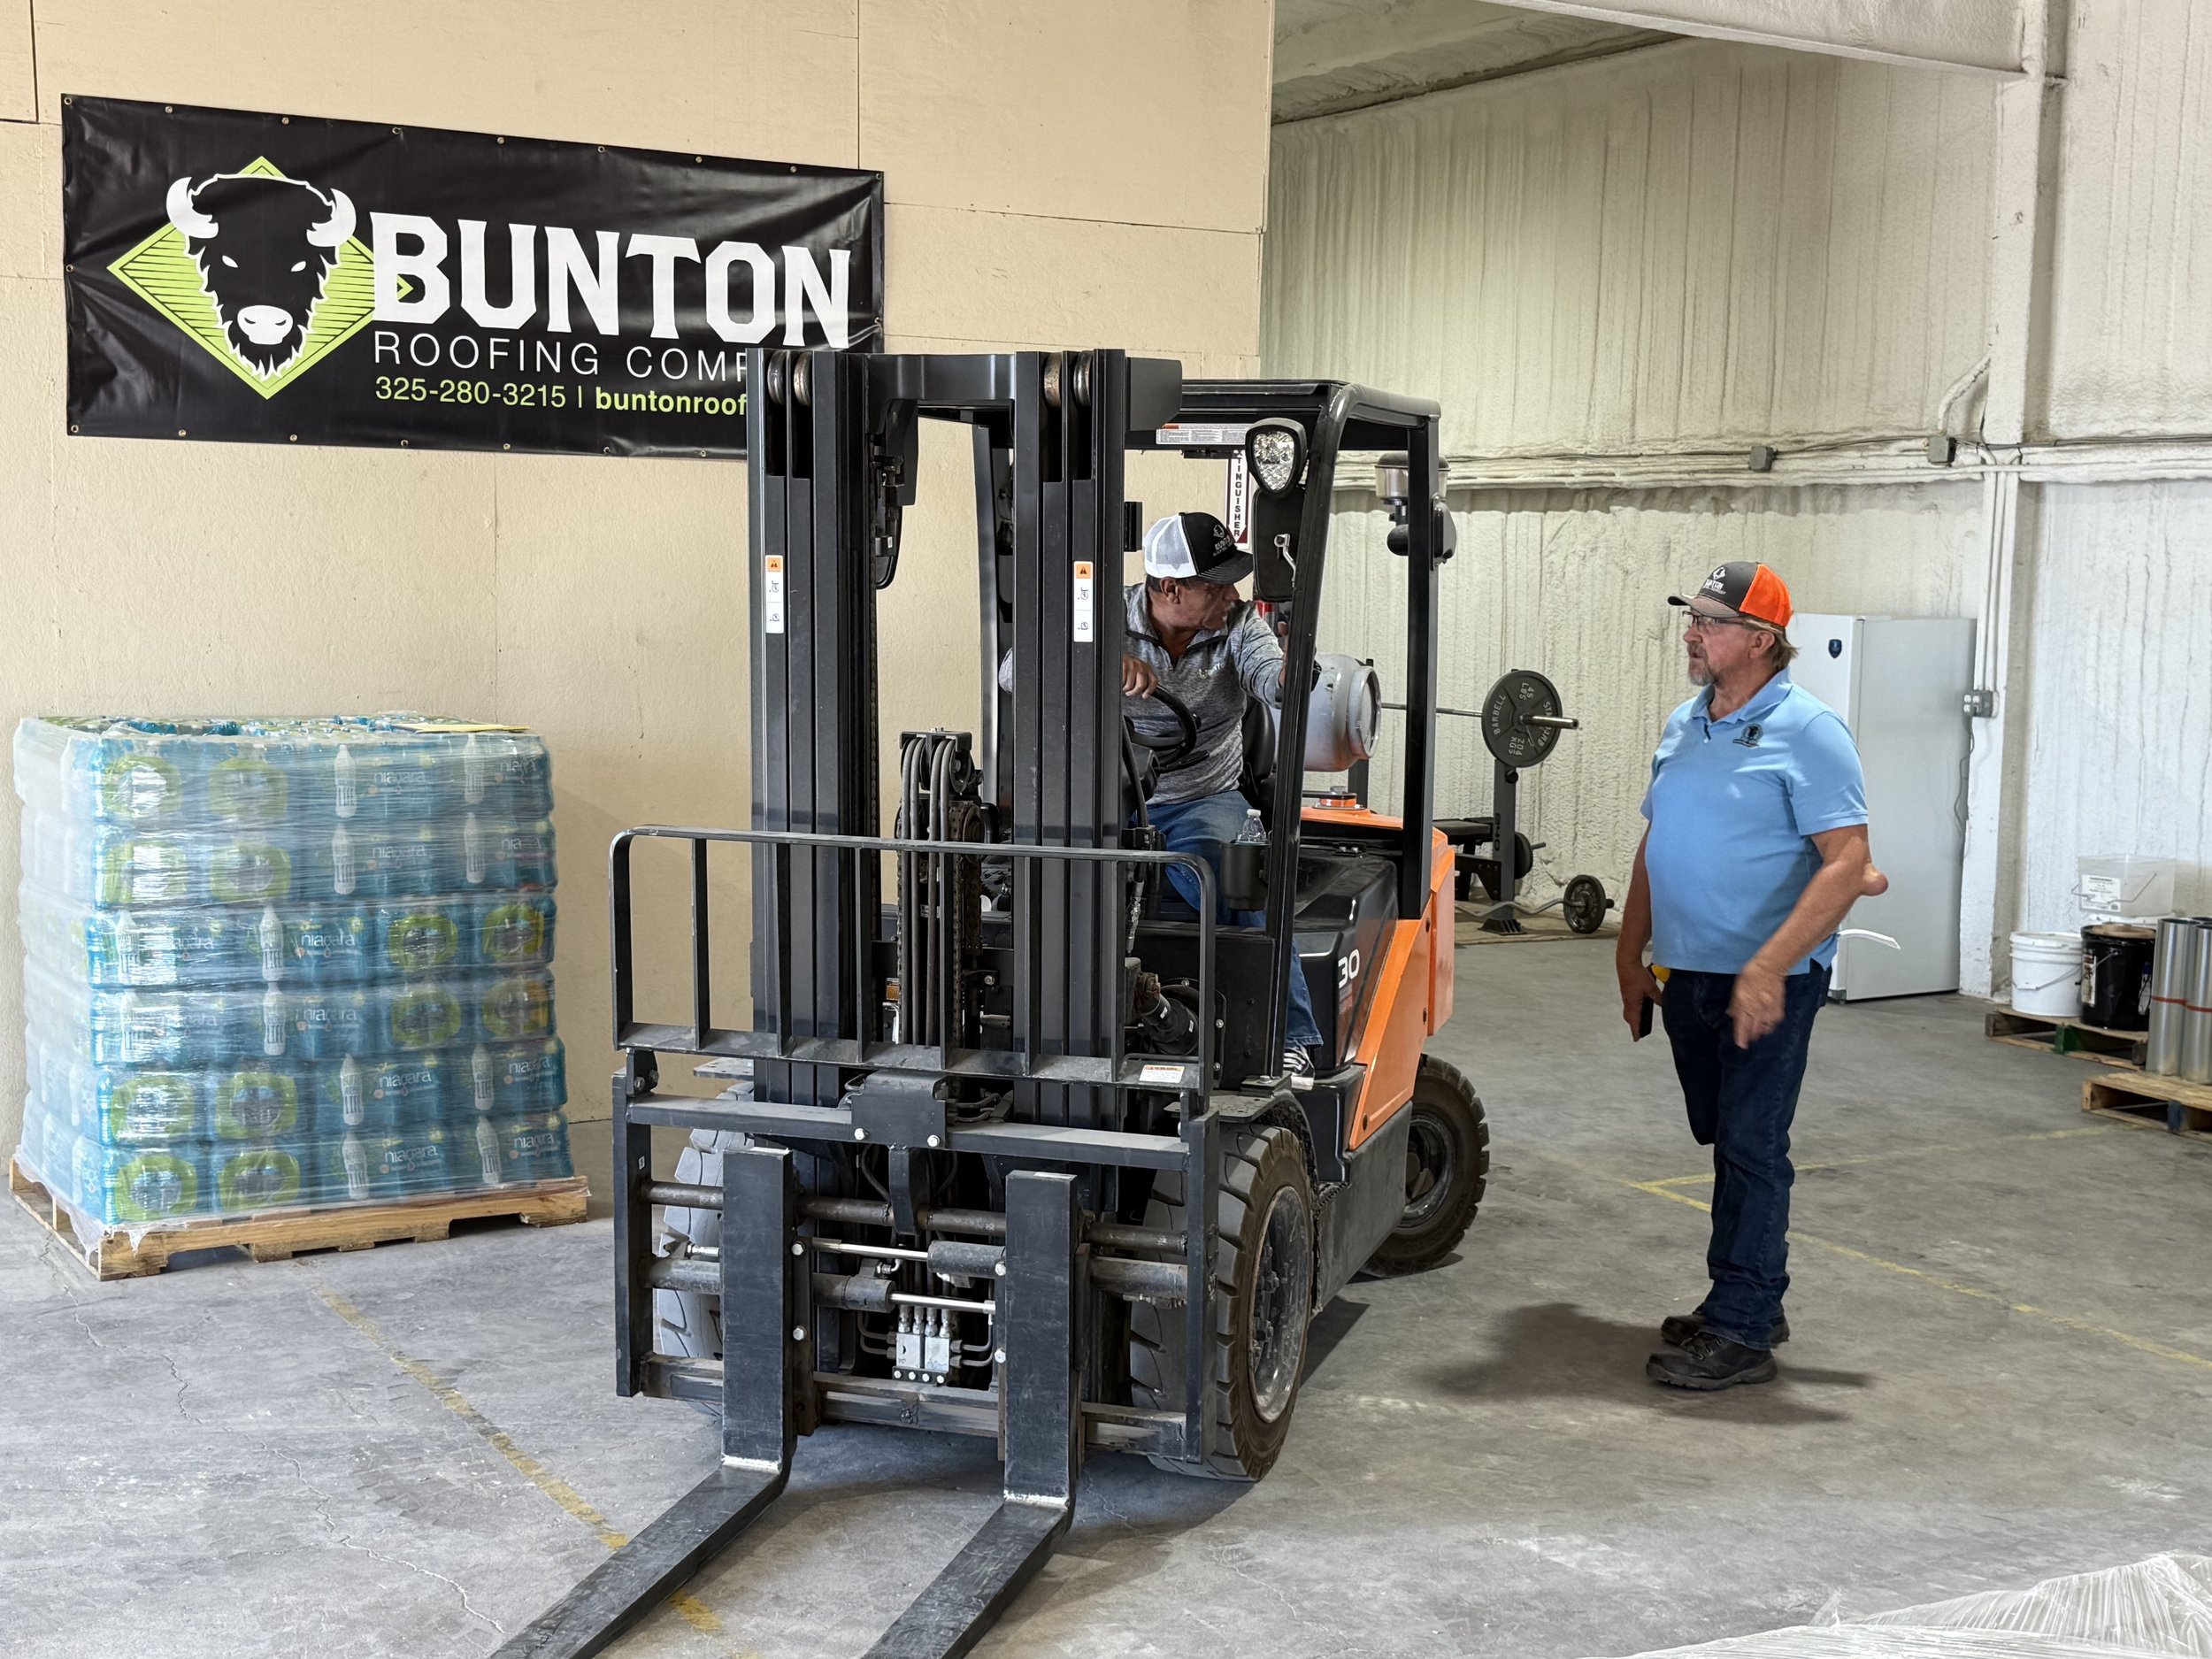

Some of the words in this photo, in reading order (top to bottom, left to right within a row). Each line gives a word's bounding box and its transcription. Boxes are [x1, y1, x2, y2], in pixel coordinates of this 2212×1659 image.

[370, 211, 851, 349] BUNTON
[374, 331, 600, 375] ROOFING
[375, 376, 566, 409] 325-280-3215
[1492, 695, 1506, 735] BARBELL
[1509, 736, 1517, 755] KGS
[301, 934, 355, 953] niagara
[1338, 949, 1360, 989] 30
[379, 1070, 432, 1092] niagara
[384, 1145, 439, 1167] niagara
